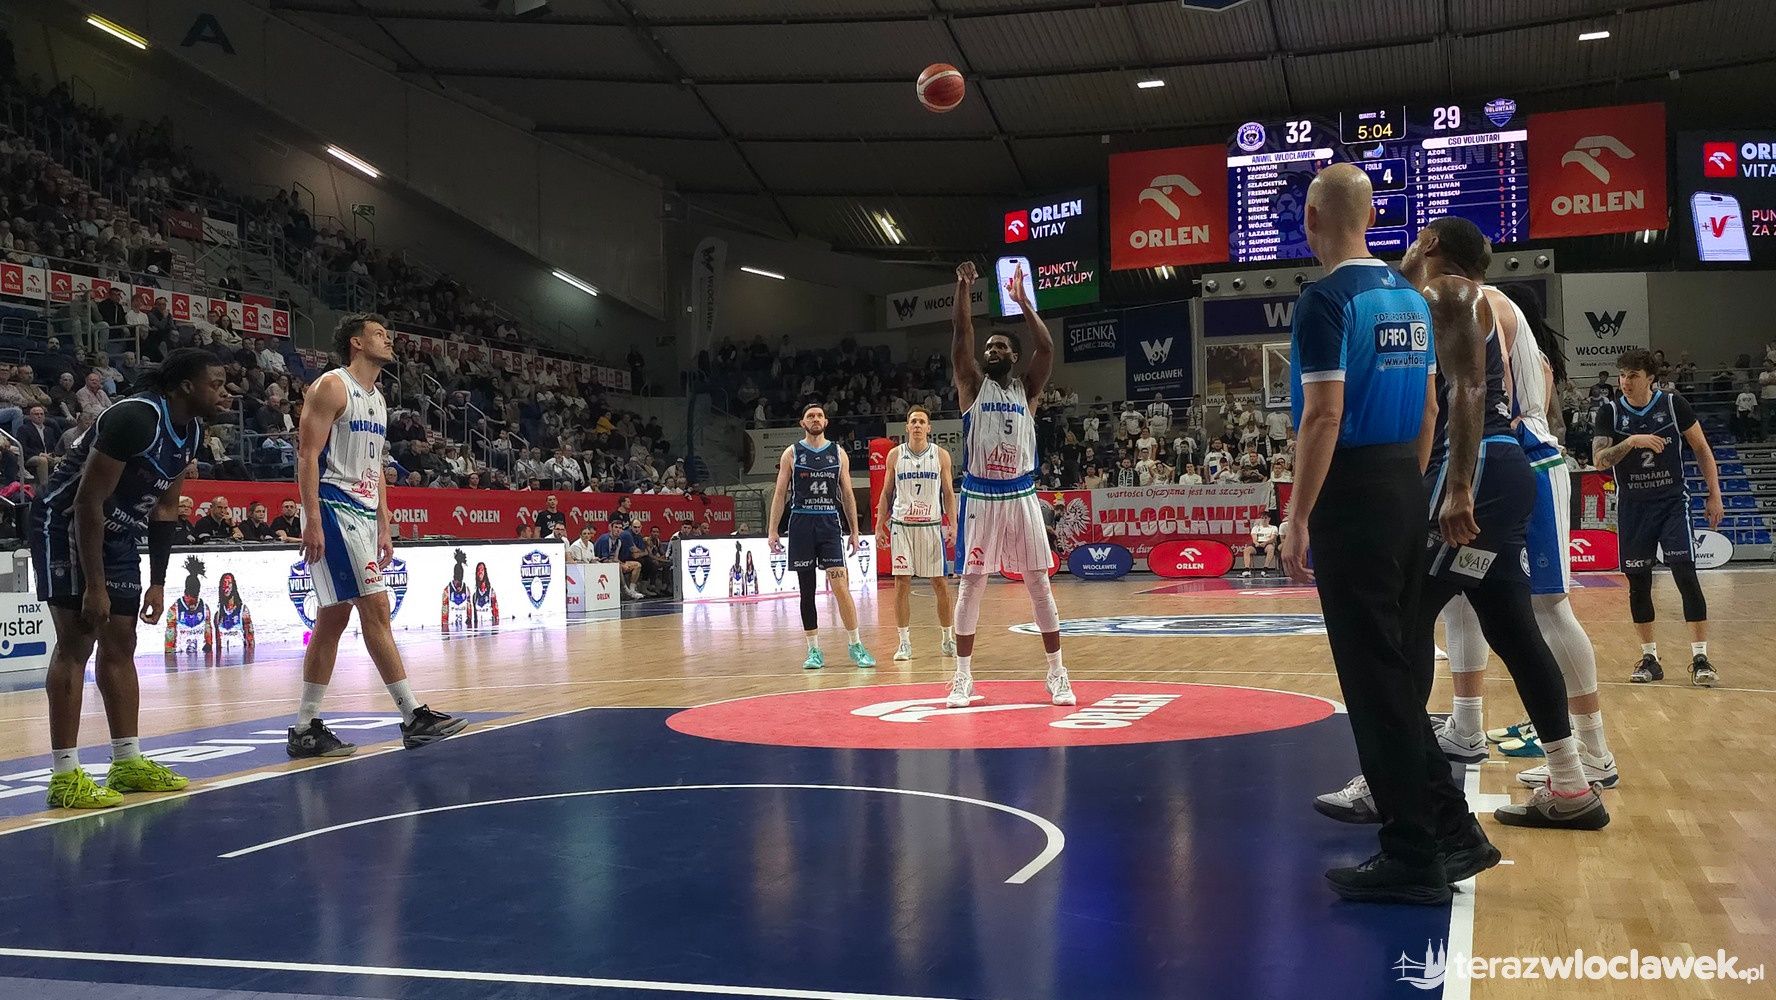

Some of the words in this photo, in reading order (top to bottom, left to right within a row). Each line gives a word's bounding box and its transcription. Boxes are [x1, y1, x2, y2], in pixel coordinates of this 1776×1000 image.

[1433, 106, 1461, 130] 29
[1286, 121, 1312, 143] 32
[1358, 123, 1392, 139] 5:04
[1448, 134, 1462, 146] CSO
[1463, 132, 1500, 144] VOLUNTARI
[1252, 154, 1272, 163] ANWIL
[1383, 169, 1392, 184] 4
[1551, 190, 1644, 216] ORLEN
[1030, 199, 1082, 224] ORLEN
[1031, 221, 1066, 239] VITAY
[1130, 224, 1210, 249] ORLEN
[1752, 225, 1770, 236] ZA
[1038, 261, 1078, 278] PUNKTY
[1038, 278, 1052, 290] ZA
[1054, 271, 1093, 288] ZAKUPY
[1070, 324, 1116, 346] SELENKA
[1134, 368, 1183, 382] WŁOCŁAWEK
[1004, 419, 1013, 434] 5
[370, 442, 374, 459] 0
[1640, 451, 1655, 468] 2
[897, 472, 938, 480] WŁOCŁAWEK
[810, 481, 828, 494] 44
[915, 484, 921, 495] 7
[1628, 478, 1673, 490] VOLUNTARI
[1106, 489, 1143, 499] wartości
[1146, 487, 1185, 499] Ojczyzna
[1187, 488, 1203, 498] jest
[1219, 486, 1255, 497] szczycie
[394, 509, 428, 523] ORLEN
[583, 510, 608, 522] ORLEN
[674, 511, 694, 521] ORLEN
[714, 511, 732, 521] ORLEN
[905, 502, 931, 516] Anwil
[470, 510, 500, 523] ORLEN
[629, 511, 650, 522] ORLEN
[521, 566, 550, 578] VOLUNTARI
[596, 593, 610, 601] ORLEN
[18, 604, 41, 613] max
[1048, 694, 1183, 728] ORLEN
